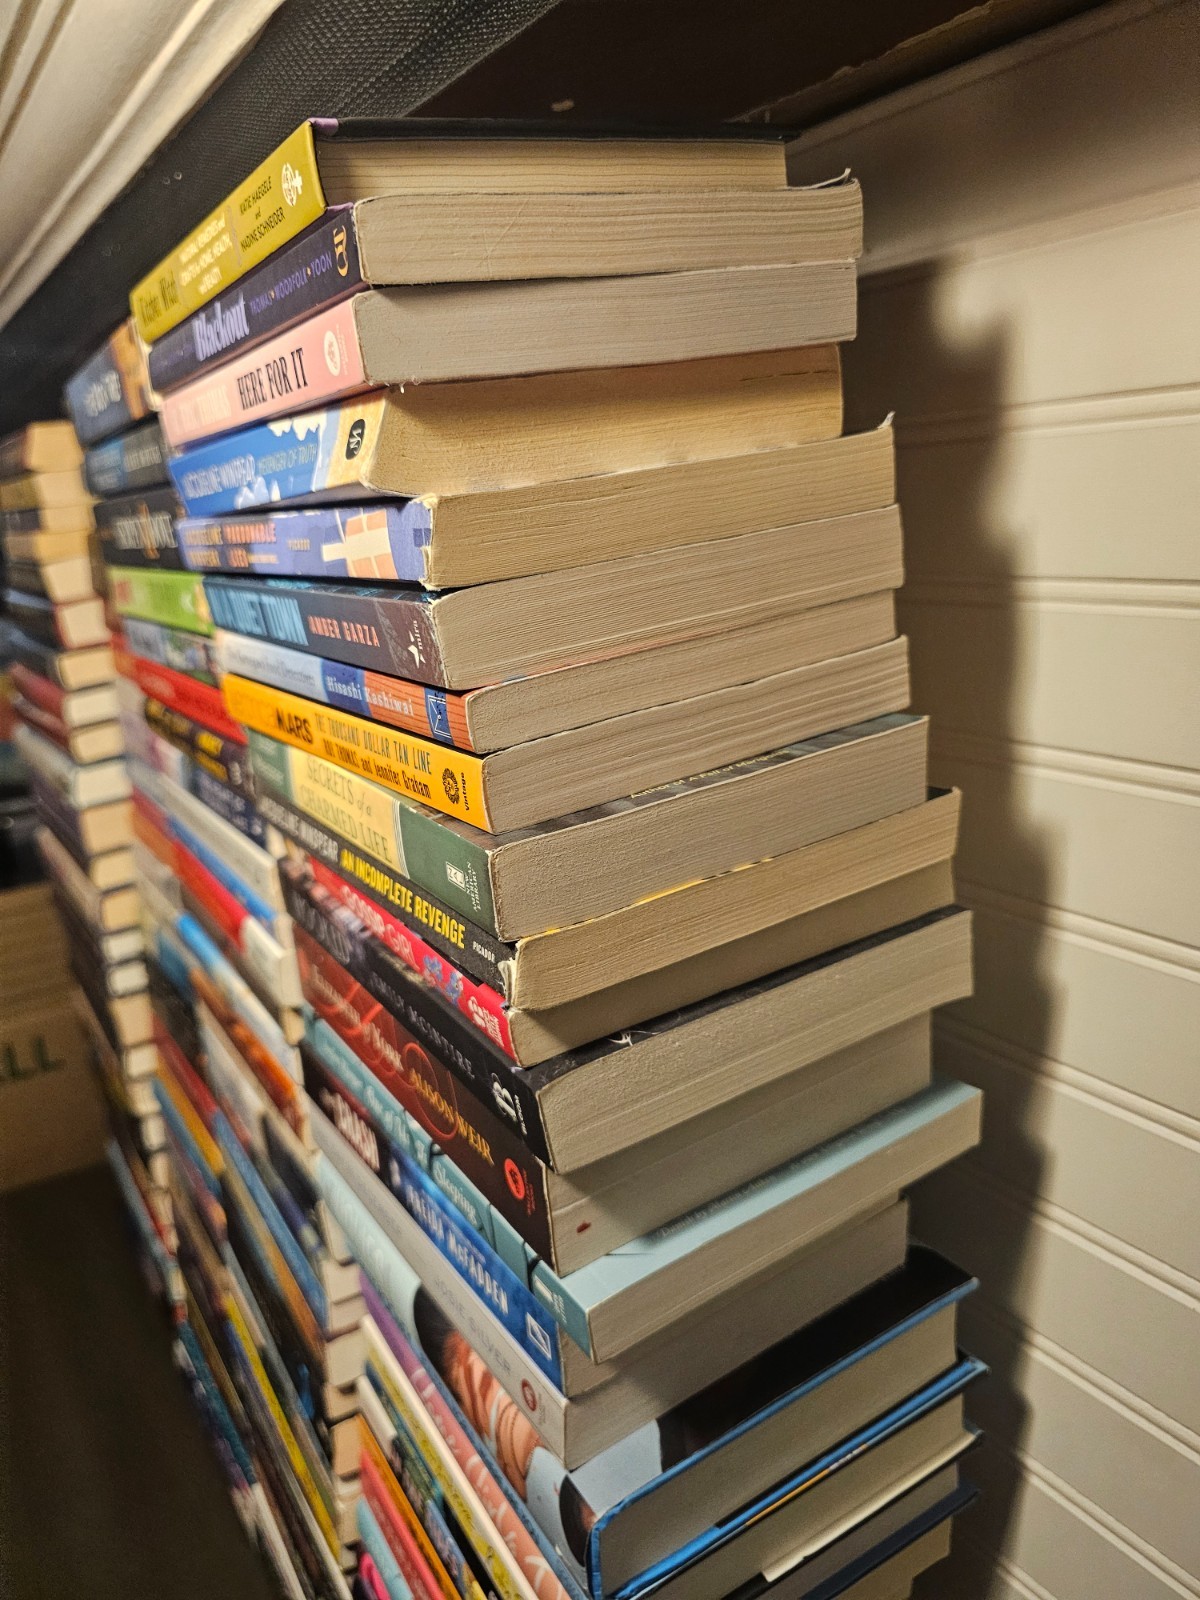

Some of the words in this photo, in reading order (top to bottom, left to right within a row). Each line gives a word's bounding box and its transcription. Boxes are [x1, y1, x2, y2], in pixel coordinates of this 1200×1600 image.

[250, 175, 273, 206] HAEGELE
[240, 226, 259, 252] NADINE
[257, 205, 285, 238] SCHNEIDER
[192, 291, 250, 362] Blackout
[274, 265, 307, 302] WOODFOLK
[310, 248, 333, 280] YOON
[236, 366, 268, 411] HERE
[265, 354, 292, 400] FOR
[290, 346, 308, 390] IT
[298, 442, 316, 466] TRUTH
[306, 614, 341, 639] AMBER
[341, 621, 380, 648] GARZA
[412, 620, 424, 650] mira
[326, 676, 362, 701] Hisashi
[363, 686, 414, 716] Kashiwai
[274, 706, 313, 744] MARS
[327, 717, 361, 747] THOUSAND
[362, 729, 390, 758] DOLLAR
[392, 740, 409, 766] TAN
[411, 746, 432, 775] LINE
[306, 755, 355, 806] SECRETS
[360, 756, 373, 774] and
[373, 759, 400, 786] Jennifer
[401, 770, 431, 799] Graham
[631, 783, 671, 799] Author
[673, 779, 686, 787] of
[699, 769, 721, 779] Fall
[361, 819, 393, 864] LIFE
[354, 855, 413, 913] INCOMPLETE
[413, 896, 466, 949] REVENGE
[472, 940, 497, 963] PICADOR
[408, 1062, 455, 1126] ALISON
[454, 1108, 495, 1168] WEIR
[431, 1159, 478, 1226] Sleeping
